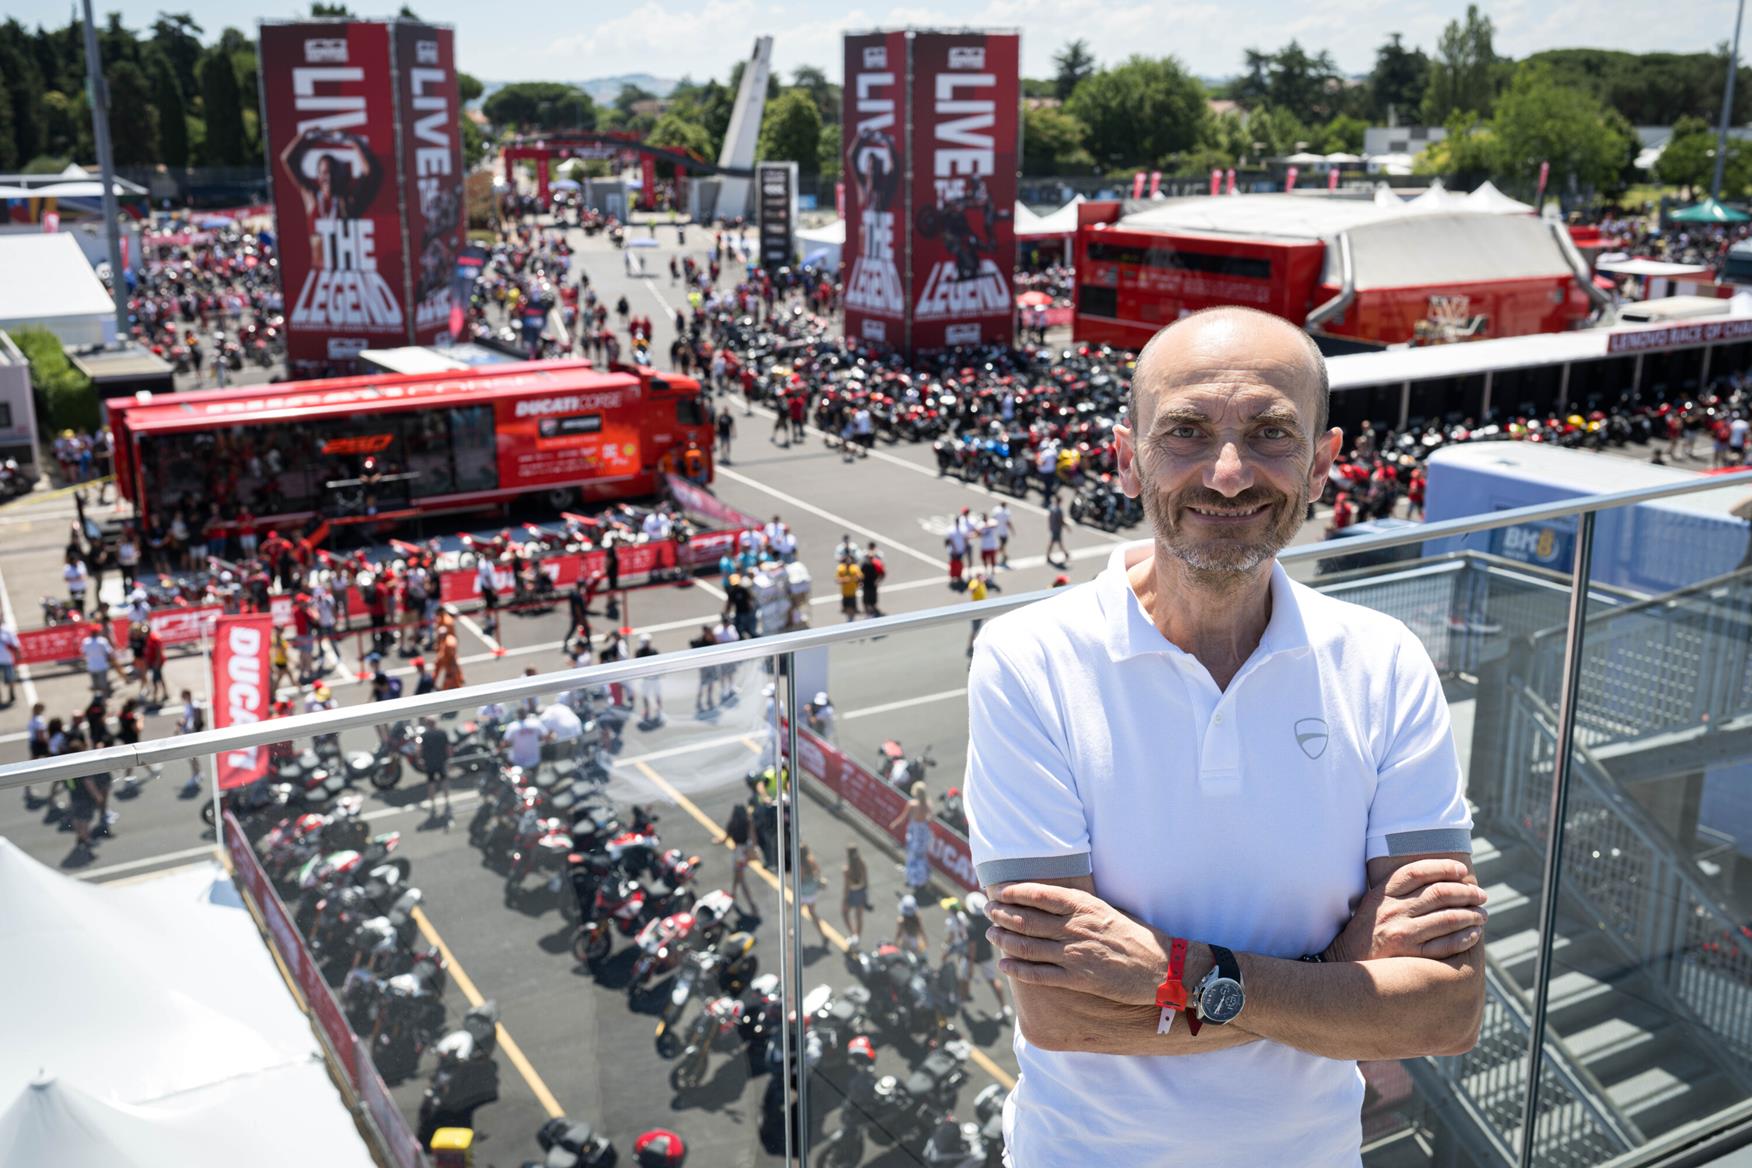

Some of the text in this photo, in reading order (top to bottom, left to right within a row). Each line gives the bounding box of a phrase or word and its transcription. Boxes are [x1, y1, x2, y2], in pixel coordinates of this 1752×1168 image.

[411, 67, 452, 176] LIVE
[934, 73, 996, 177] LIVE
[314, 219, 378, 271] THE
[862, 210, 895, 260] THE
[290, 270, 403, 325] LEGEND
[845, 257, 905, 315] LEGEND
[914, 258, 1012, 316] LEGEND
[228, 627, 261, 770] DUCAI
